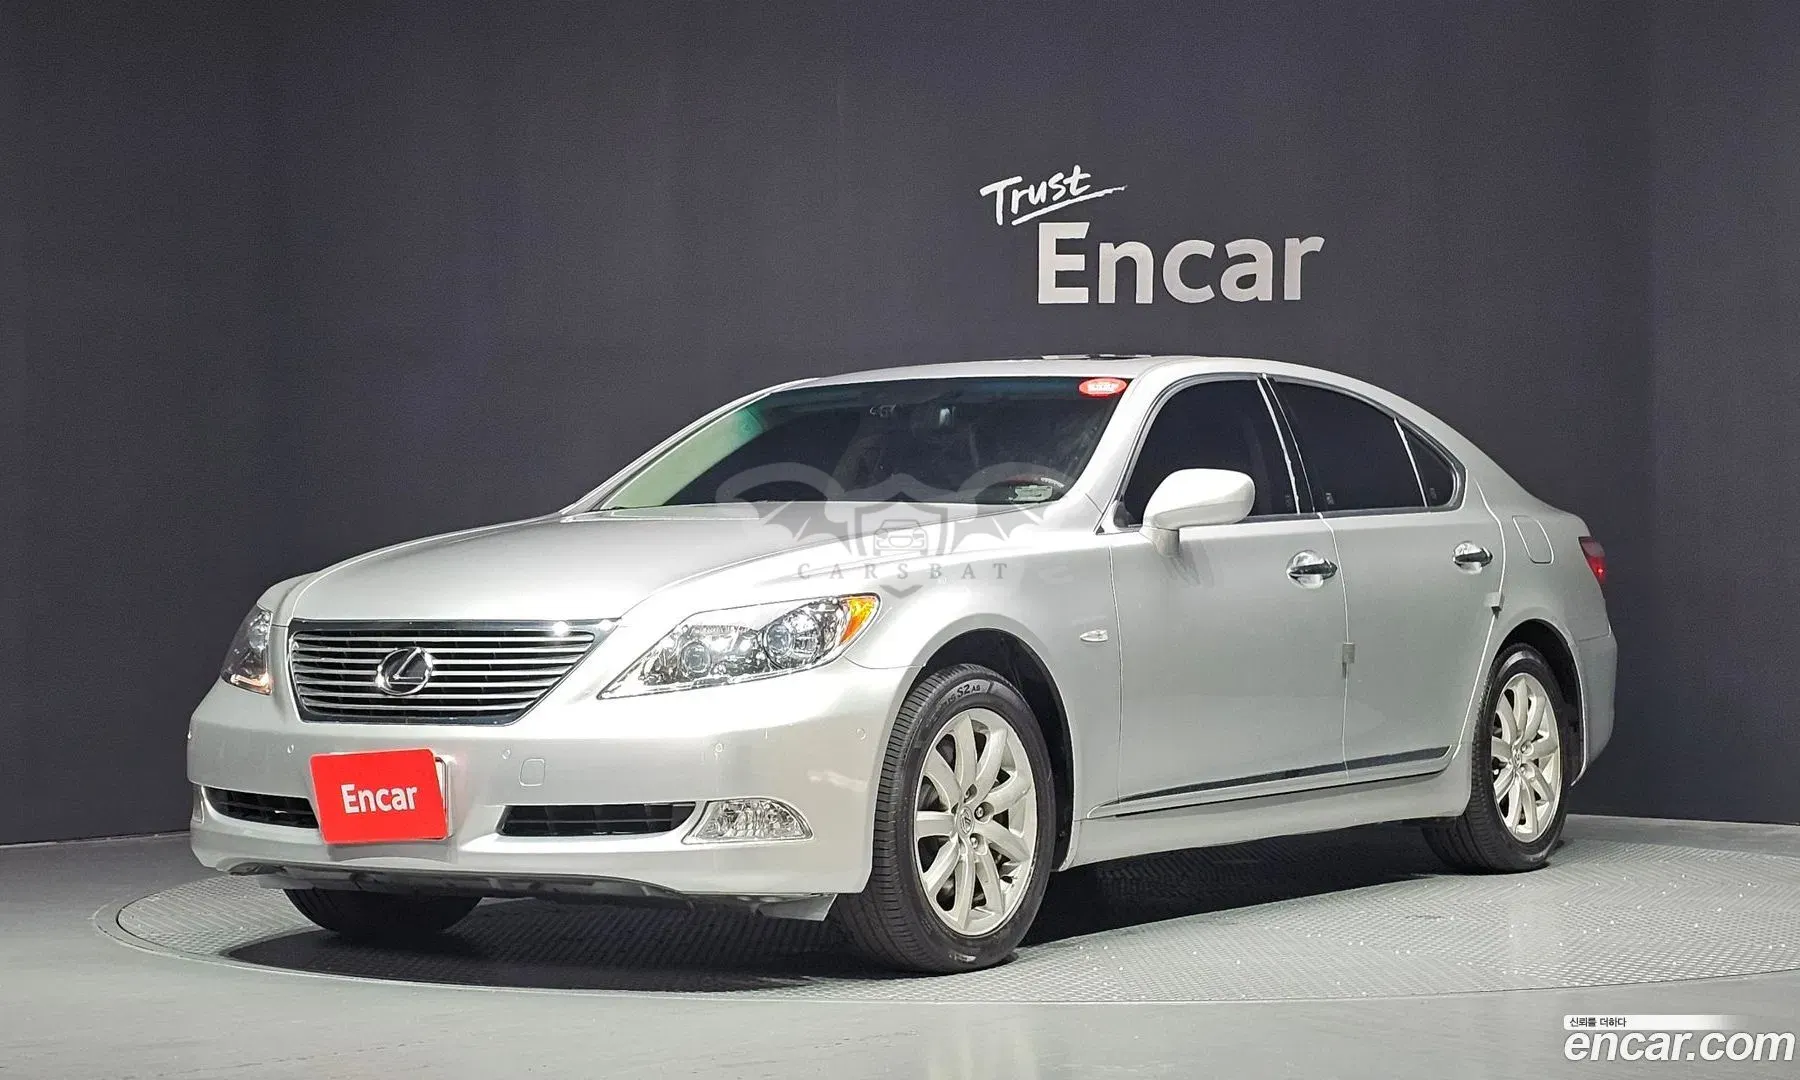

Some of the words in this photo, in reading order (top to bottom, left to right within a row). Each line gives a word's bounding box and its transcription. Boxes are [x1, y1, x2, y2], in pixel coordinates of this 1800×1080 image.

[980, 165, 1091, 226] Trust
[1038, 221, 1325, 304] Encar
[956, 683, 971, 698] S2
[340, 783, 418, 814] Encar
